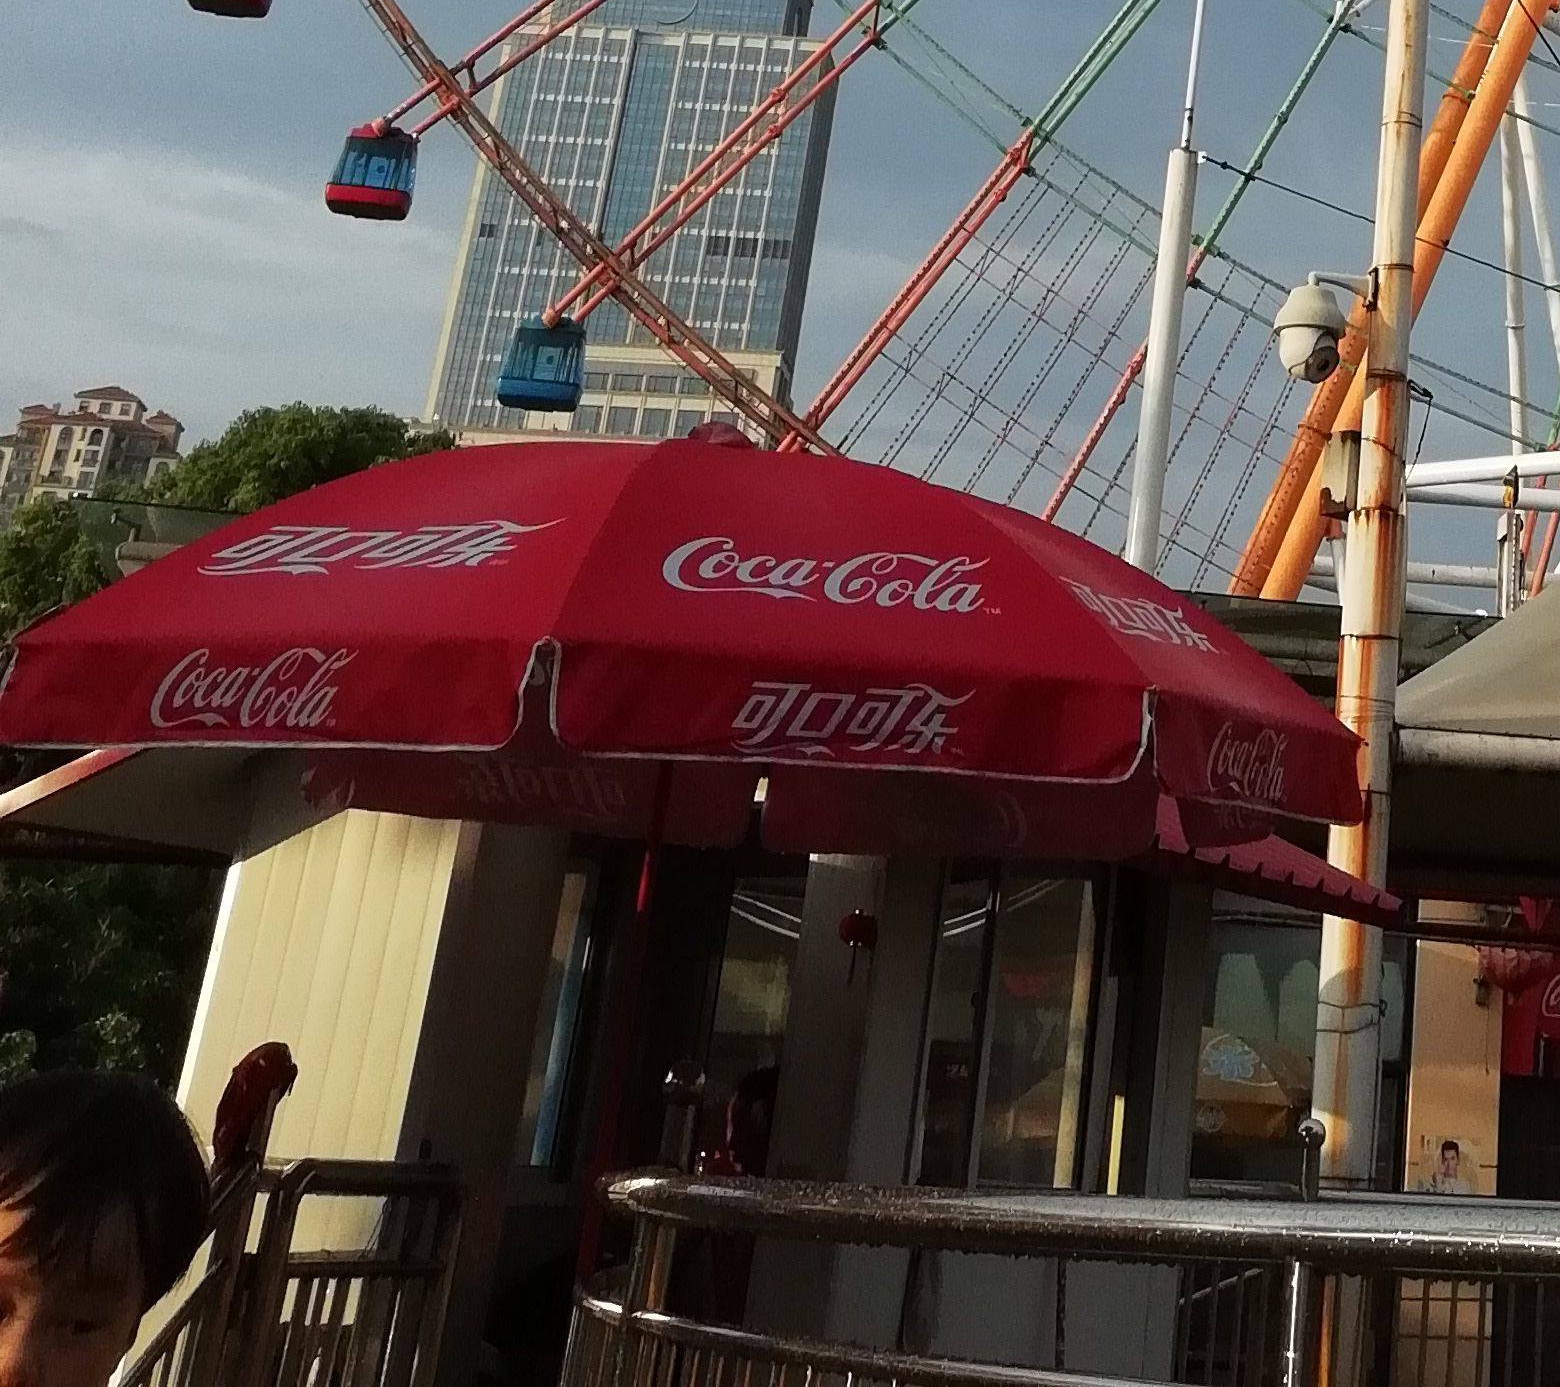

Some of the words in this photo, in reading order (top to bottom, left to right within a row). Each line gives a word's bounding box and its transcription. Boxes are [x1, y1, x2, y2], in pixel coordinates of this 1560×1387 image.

[197, 517, 568, 575] 可口可乐
[662, 536, 991, 613] Coca-Cola
[1059, 575, 1220, 655] 可口可乐
[730, 681, 977, 757] 可口可乐
